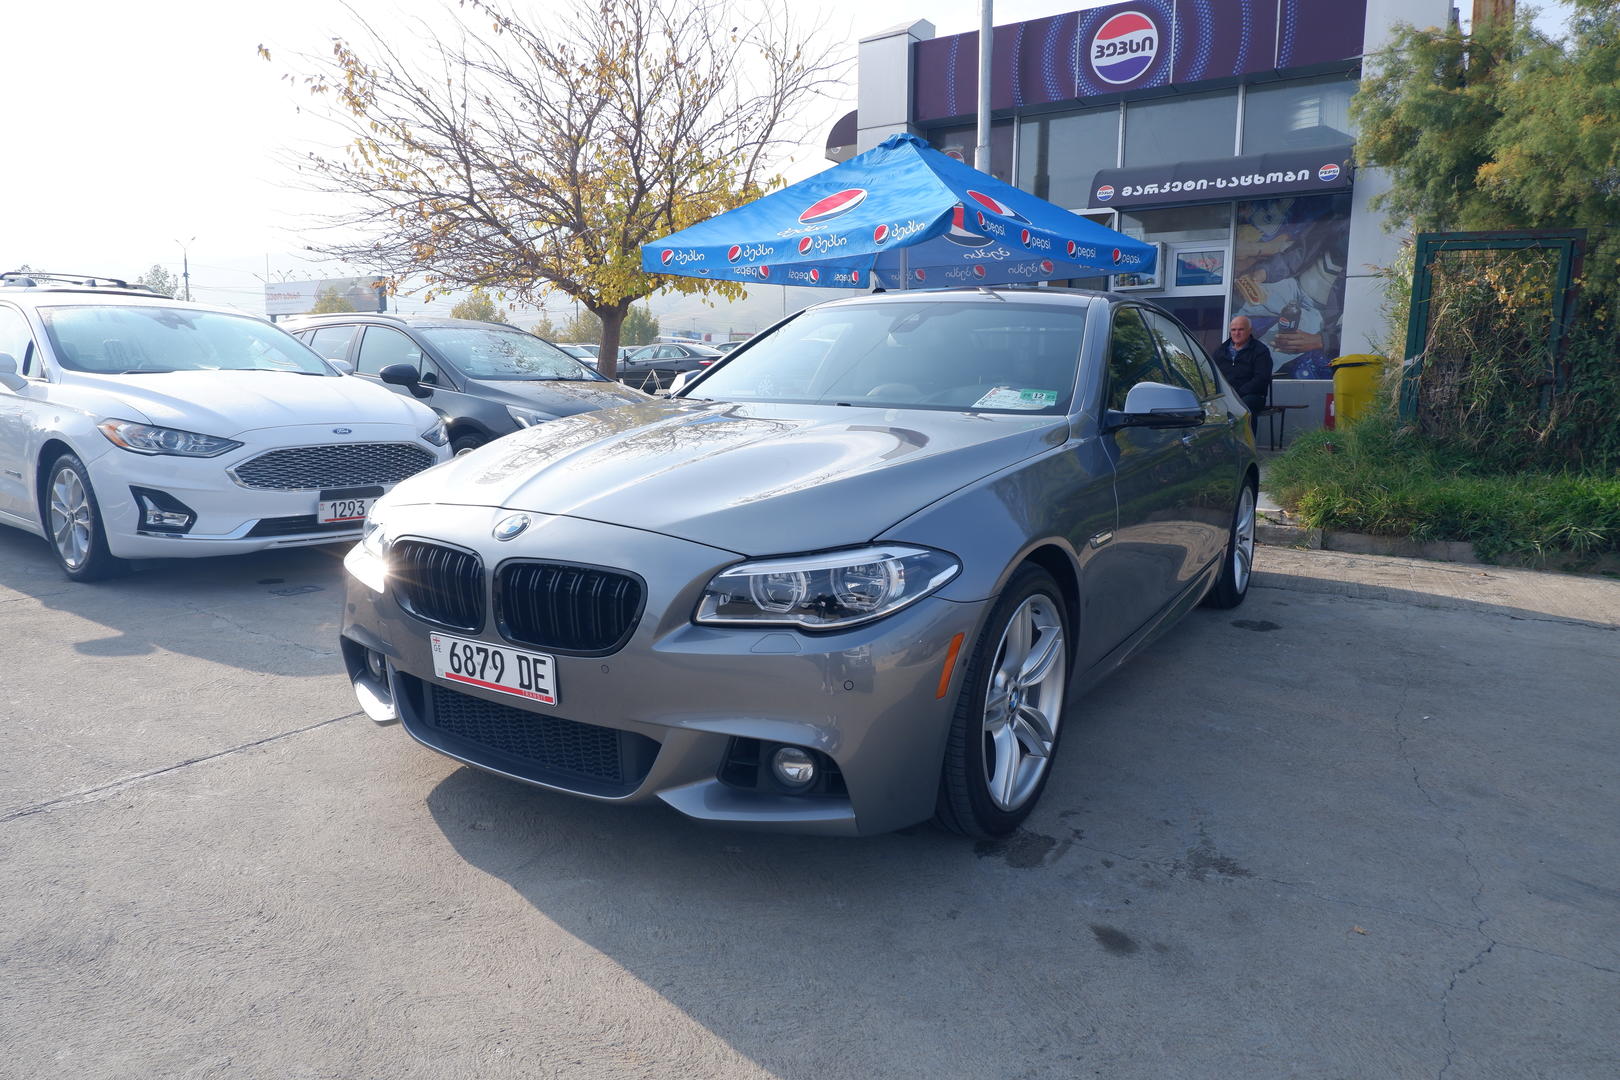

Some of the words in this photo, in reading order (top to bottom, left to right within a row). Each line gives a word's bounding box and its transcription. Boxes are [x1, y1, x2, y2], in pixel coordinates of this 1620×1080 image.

[1094, 36, 1154, 59] პეპსი
[891, 220, 926, 241] პეპსი
[986, 220, 1006, 237] pepsi
[814, 233, 847, 252] პეპსი
[1031, 236, 1051, 250] pepsi
[675, 249, 705, 265] პეპსი
[743, 243, 774, 262] პეპსი
[1077, 246, 1097, 259] pepsi
[1120, 254, 1141, 265] pepsi
[330, 499, 365, 519] 1293
[449, 641, 505, 683] 6879
[516, 654, 550, 694] DE
